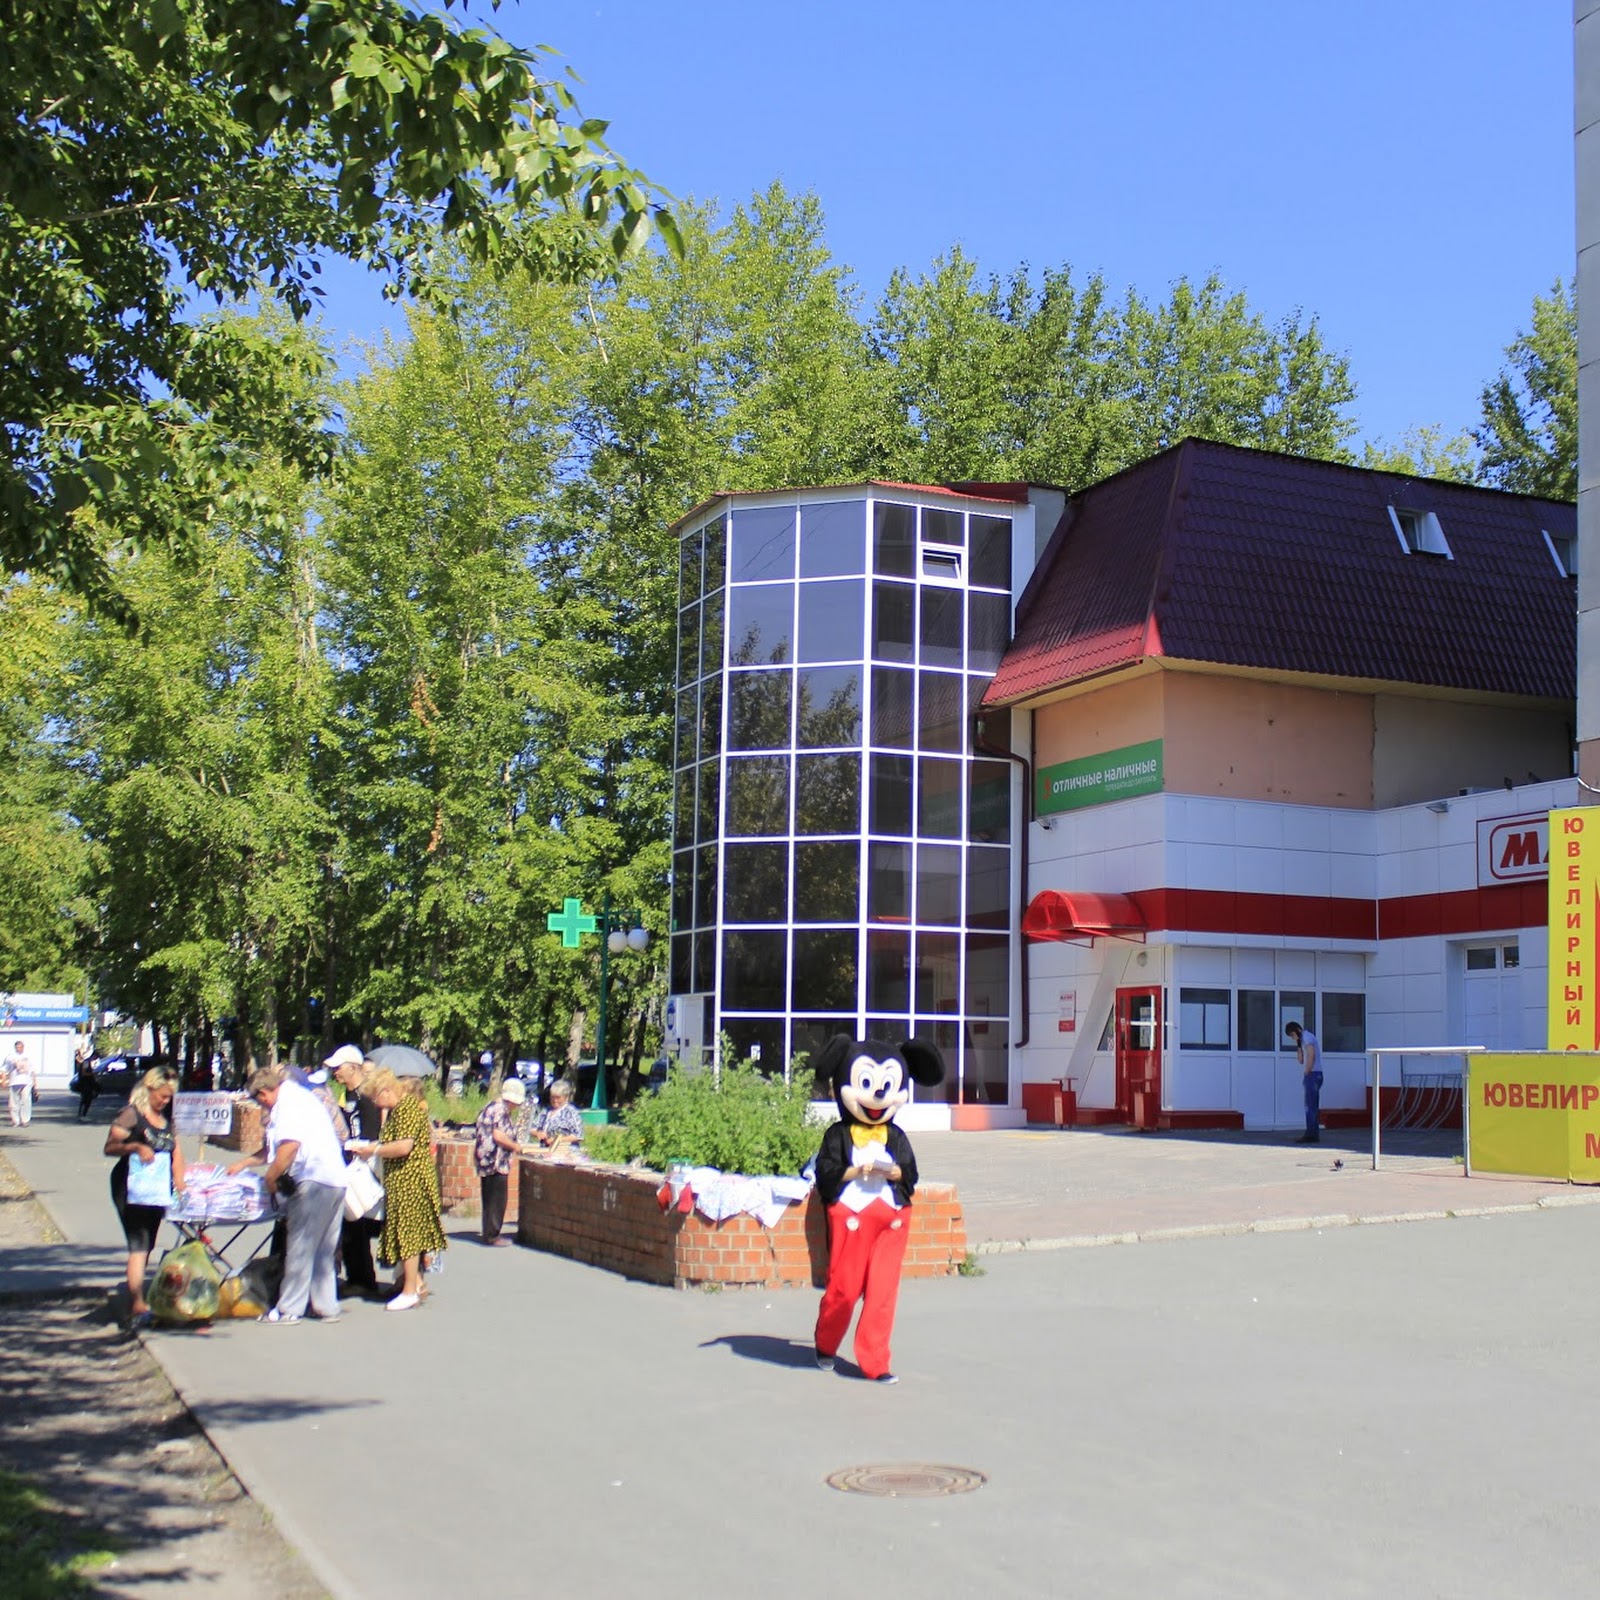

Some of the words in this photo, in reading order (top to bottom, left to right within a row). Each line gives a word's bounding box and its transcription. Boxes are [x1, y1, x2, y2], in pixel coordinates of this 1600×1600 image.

[1053, 771, 1102, 794] отличные
[1104, 759, 1157, 783] наличные
[1500, 831, 1549, 869] М
[1564, 816, 1584, 1025] ЮВЕЛИРНЫЙ
[203, 1109, 229, 1120] 100
[1484, 1083, 1600, 1111] ЮВЕЛИР
